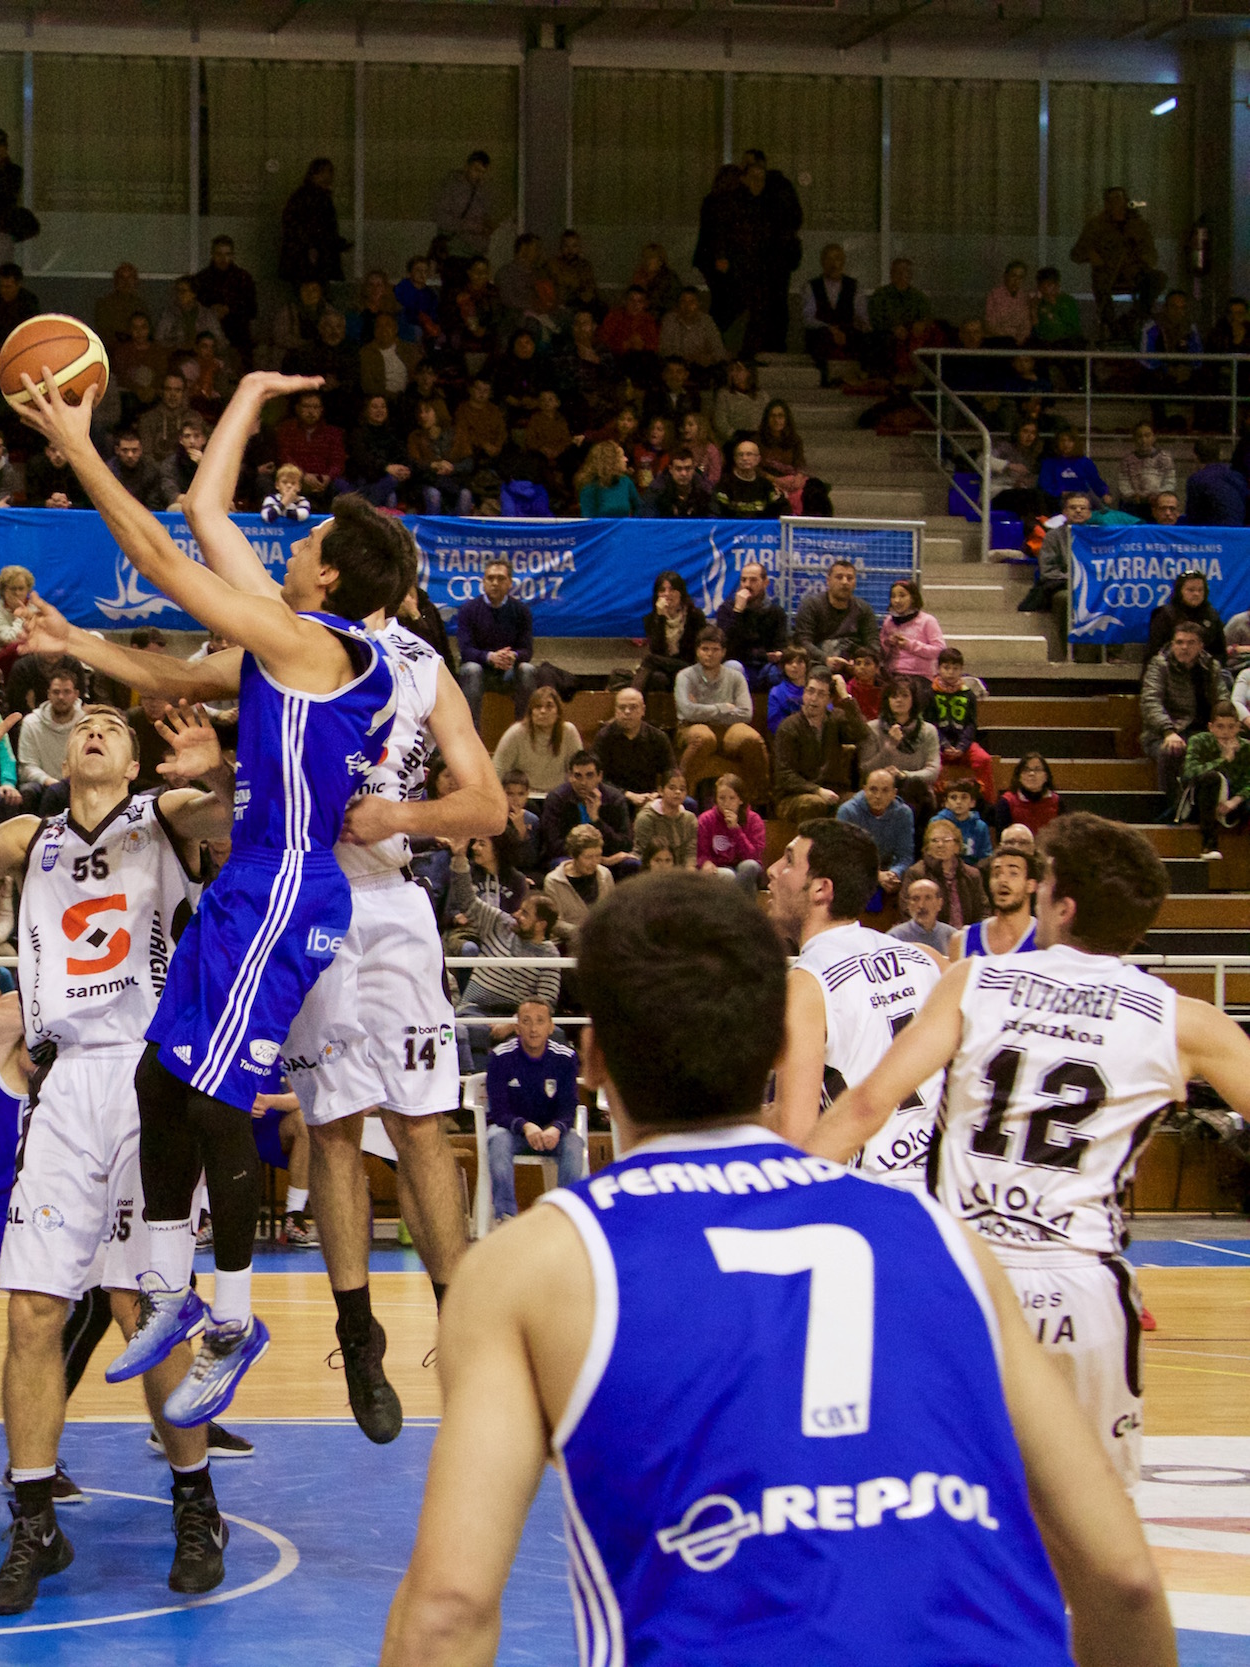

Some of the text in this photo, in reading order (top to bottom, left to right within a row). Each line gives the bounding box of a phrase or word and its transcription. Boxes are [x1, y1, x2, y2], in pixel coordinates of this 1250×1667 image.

[465, 536, 493, 546] JOCS
[760, 535, 780, 546] JOC
[1090, 556, 1223, 582] TARRAGONA
[510, 576, 564, 600] 2017
[71, 846, 110, 883] 55
[403, 1038, 437, 1072] 14
[966, 1043, 1114, 1175] 12
[703, 1222, 875, 1438] 7
[810, 1402, 861, 1431] CBT
[761, 1471, 1000, 1537] REPSOL
